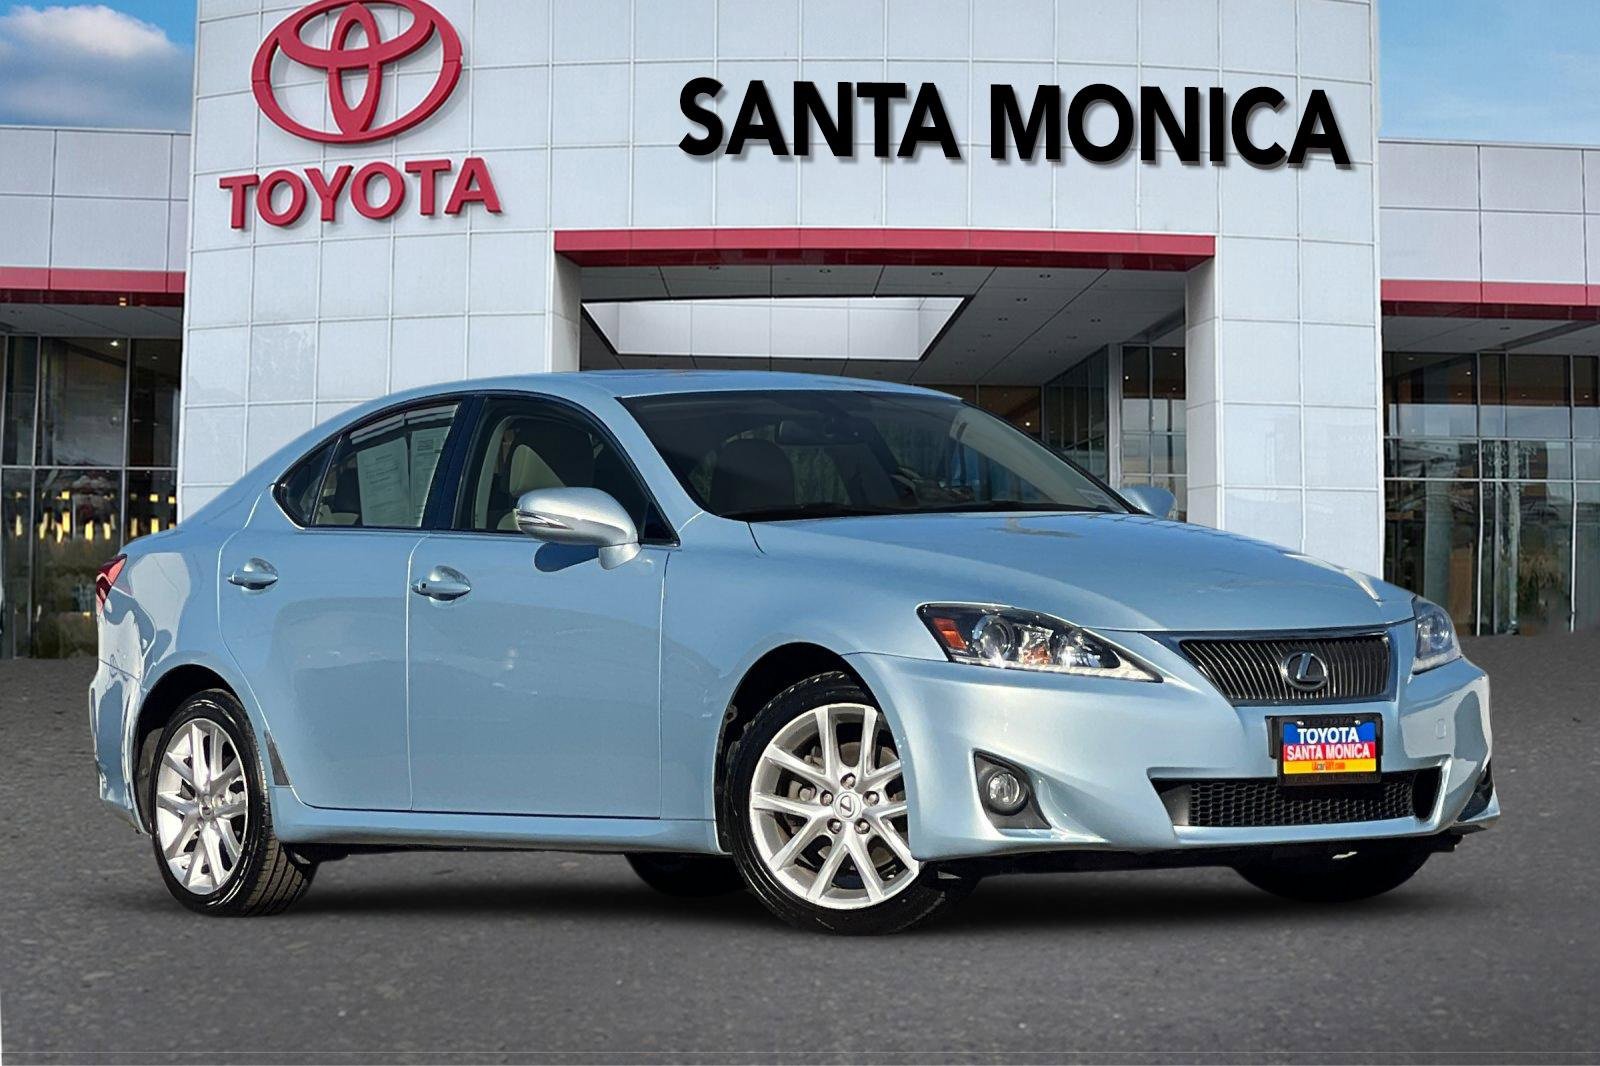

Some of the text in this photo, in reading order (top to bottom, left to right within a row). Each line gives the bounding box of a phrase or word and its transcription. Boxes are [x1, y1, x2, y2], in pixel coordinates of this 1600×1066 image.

[678, 76, 1352, 168] SANTA MONICA
[219, 157, 503, 229] TOYOTA
[1287, 743, 1371, 761] SANTA MONICA
[1297, 727, 1360, 744] TOYOTA
